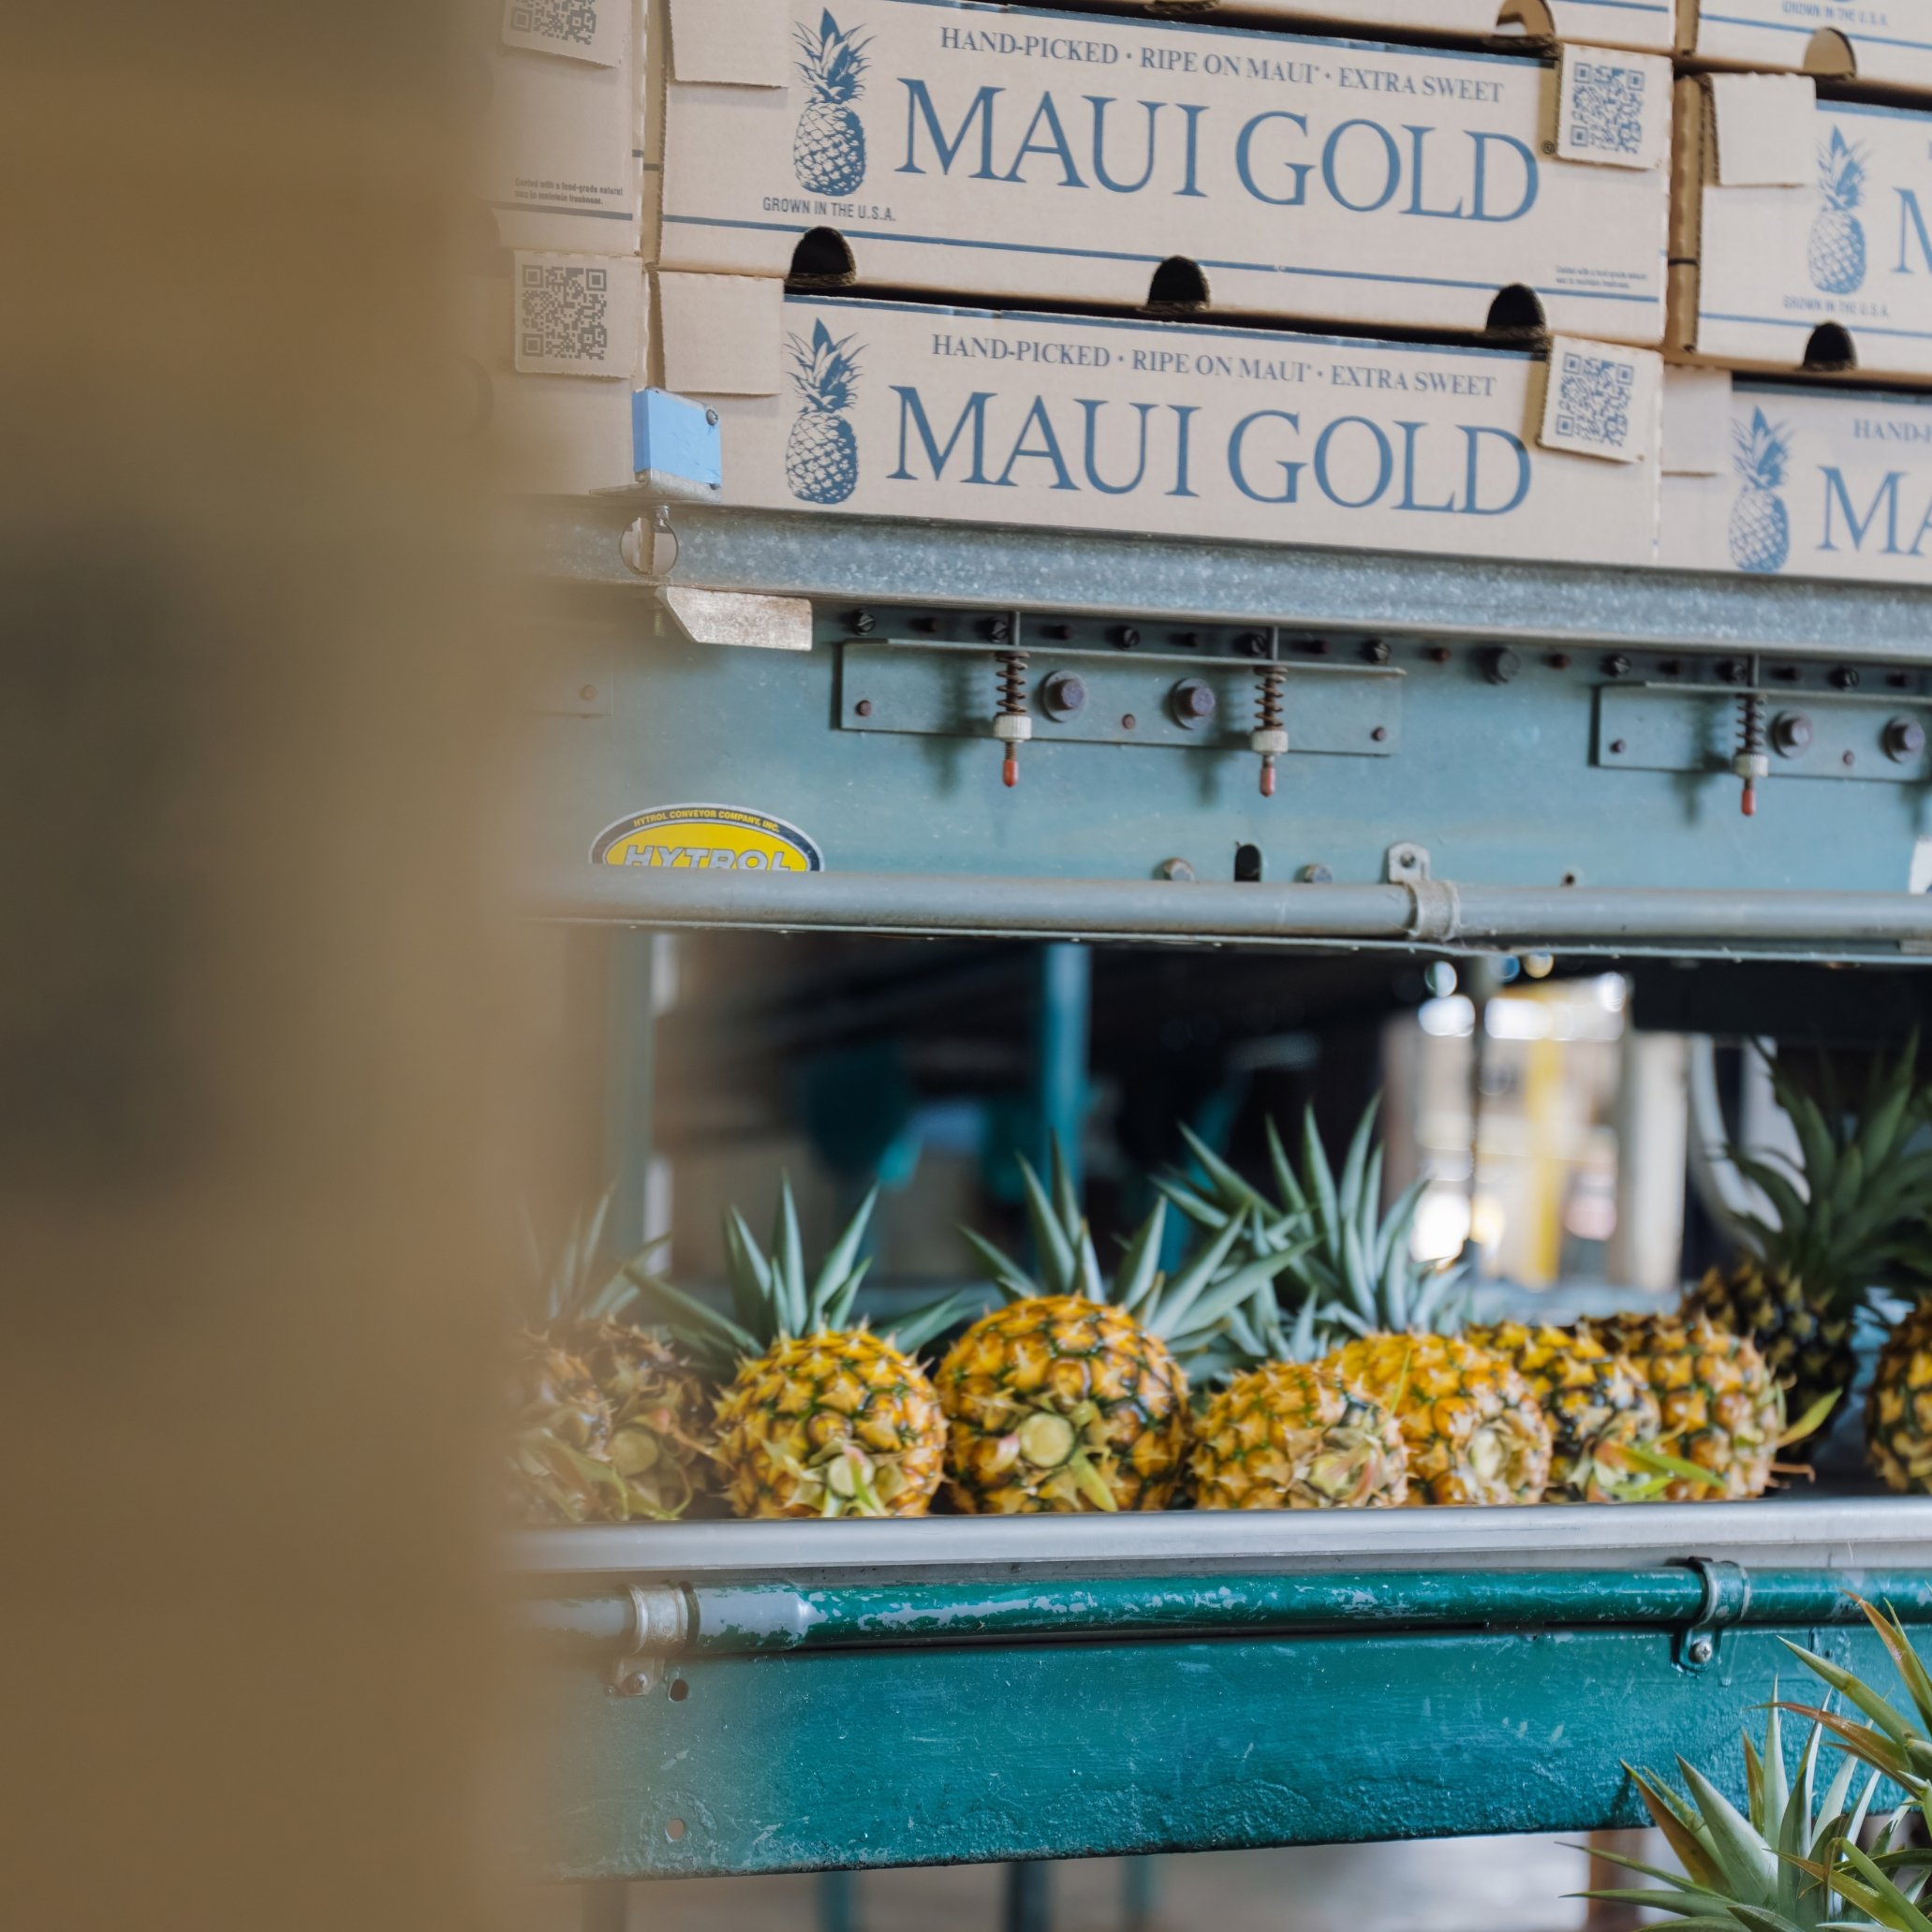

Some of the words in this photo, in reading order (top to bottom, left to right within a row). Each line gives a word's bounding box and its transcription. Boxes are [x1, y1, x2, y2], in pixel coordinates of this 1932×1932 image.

[939, 27, 1119, 64] HAND-PICKED
[1140, 47, 1199, 73] RIPE
[1202, 54, 1241, 77] ON
[1338, 66, 1417, 95] EXTRA
[1422, 75, 1505, 103] SWEET
[893, 77, 1210, 198] MAUI
[1234, 111, 1540, 223] GOLD
[763, 197, 810, 214] GROWN
[814, 200, 827, 215] IN
[831, 202, 854, 217] THE
[858, 205, 896, 221] U.S.A.
[932, 333, 1111, 368] HAND-PICKED
[1131, 349, 1190, 374] RIPE
[1195, 355, 1232, 376] ON
[1330, 364, 1409, 391] EXTRA
[1414, 371, 1497, 397] SWEET
[885, 384, 1202, 497] MAUI
[1225, 408, 1532, 516] GOLD
[633, 812, 668, 827] HYTROL
[669, 809, 717, 819] CONVEYOR
[717, 810, 761, 828] COMPANY,
[761, 819, 780, 833] INC.
[622, 845, 791, 872] HYTROL
